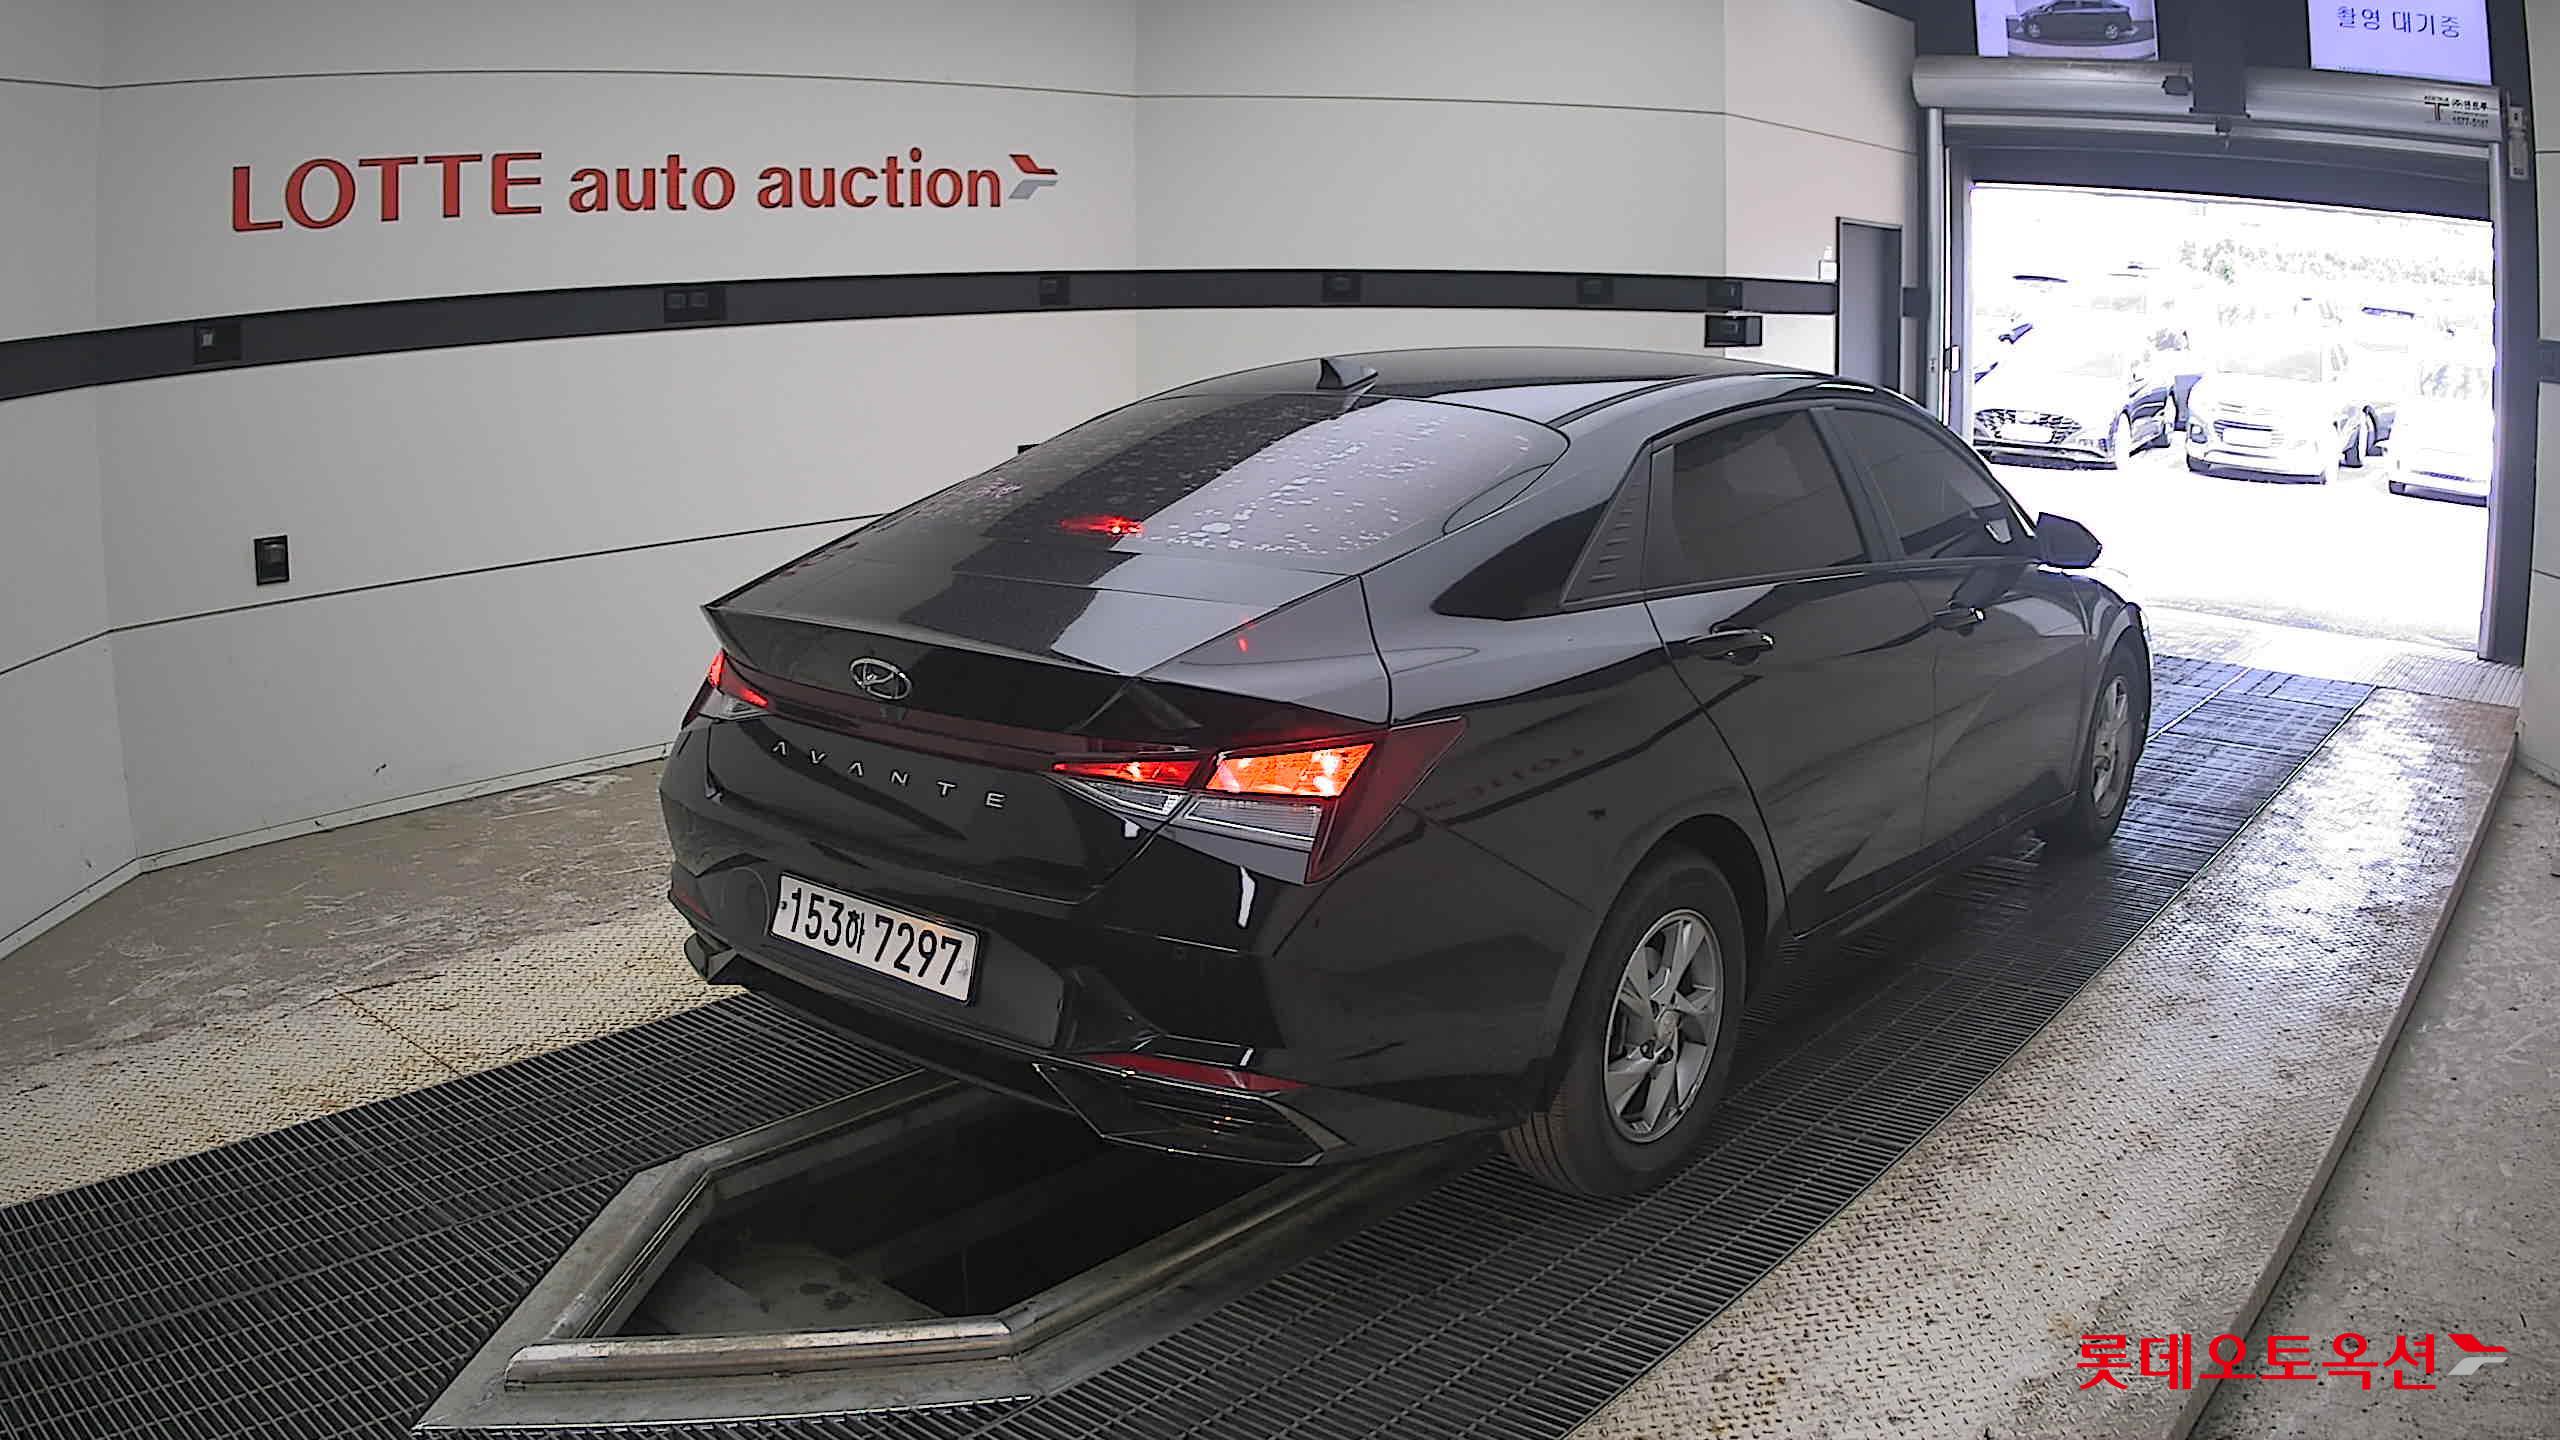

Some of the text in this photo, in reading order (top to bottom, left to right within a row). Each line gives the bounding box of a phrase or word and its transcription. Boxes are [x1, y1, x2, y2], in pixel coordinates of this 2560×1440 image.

[2337, 6, 2461, 39] 촬영 대기중
[232, 147, 1003, 233] LOTTE auto auction
[772, 740, 1006, 809] AVANTE
[875, 913, 963, 987] 7297
